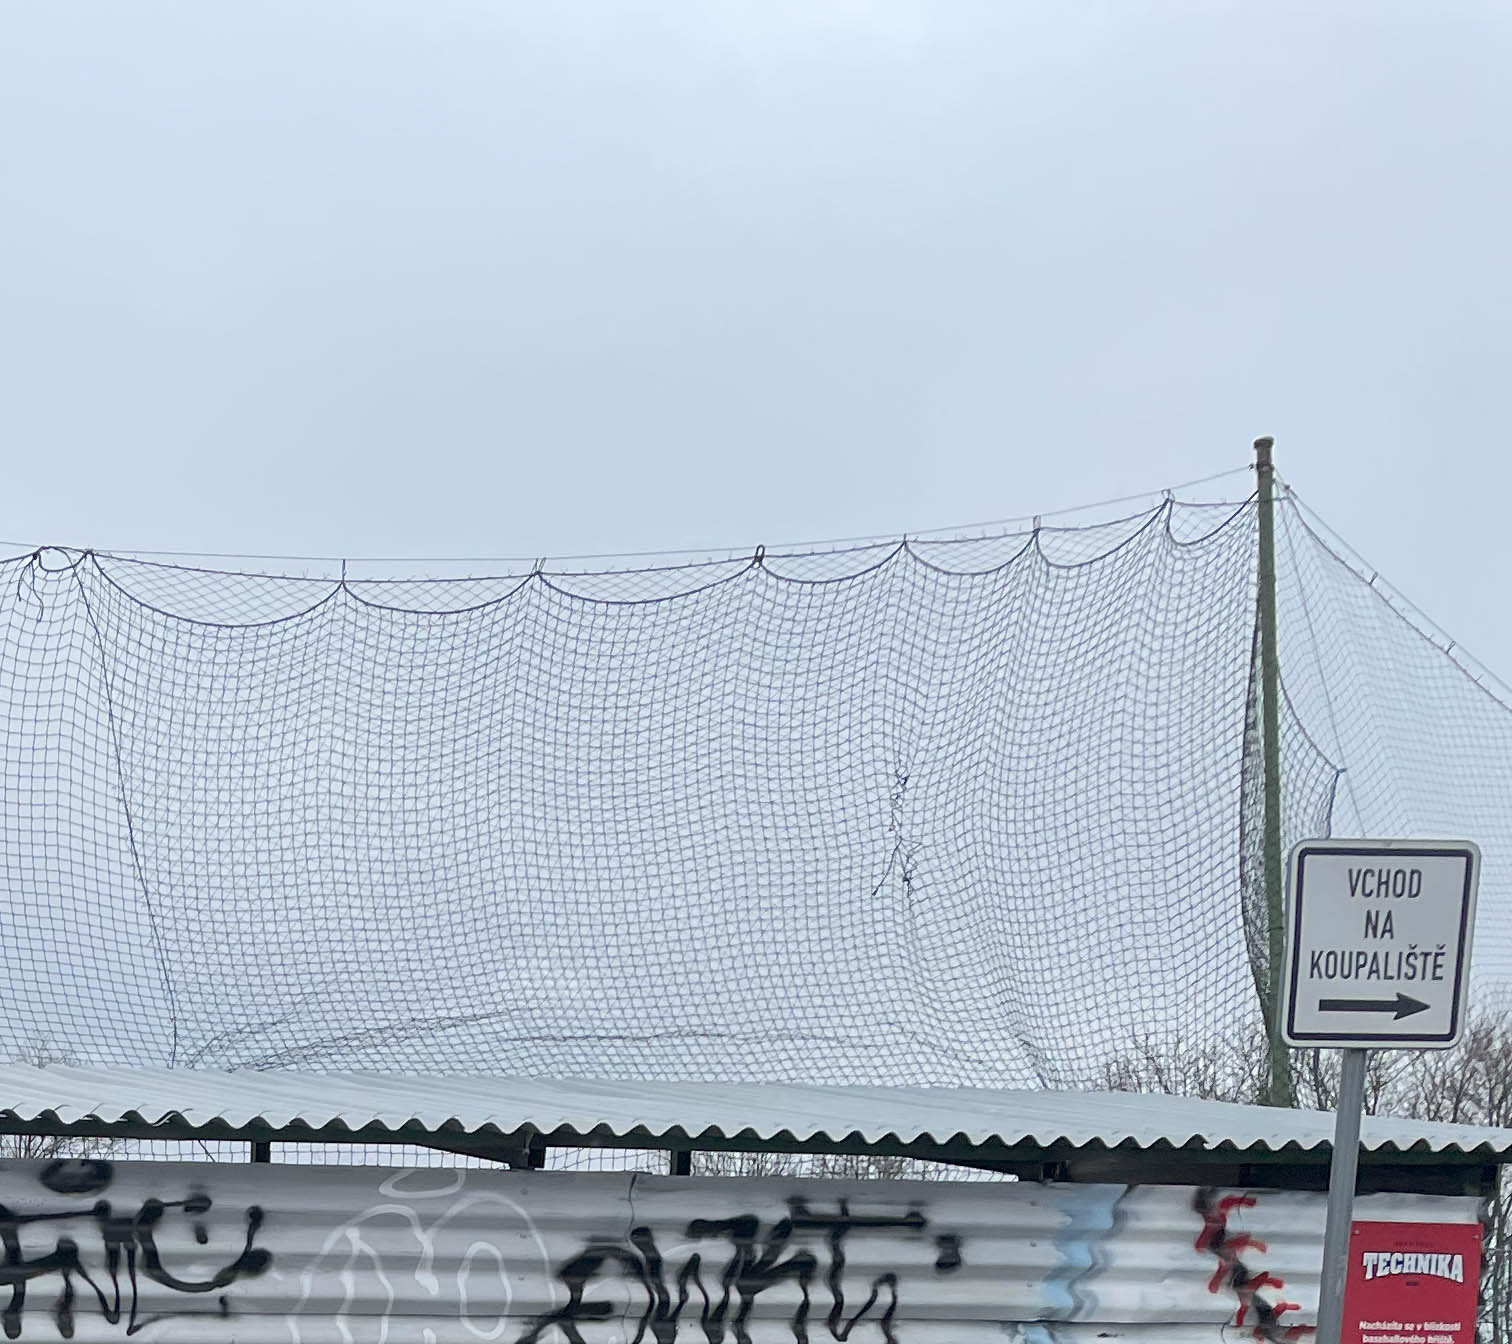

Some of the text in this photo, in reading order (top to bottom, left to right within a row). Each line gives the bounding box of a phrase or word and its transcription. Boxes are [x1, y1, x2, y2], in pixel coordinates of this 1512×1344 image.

[1347, 867, 1422, 899] VCHOD
[1364, 909, 1395, 940] NA
[1309, 944, 1446, 981] KOUPALIŠTĚ
[1362, 1252, 1464, 1284] TECHNIKA
